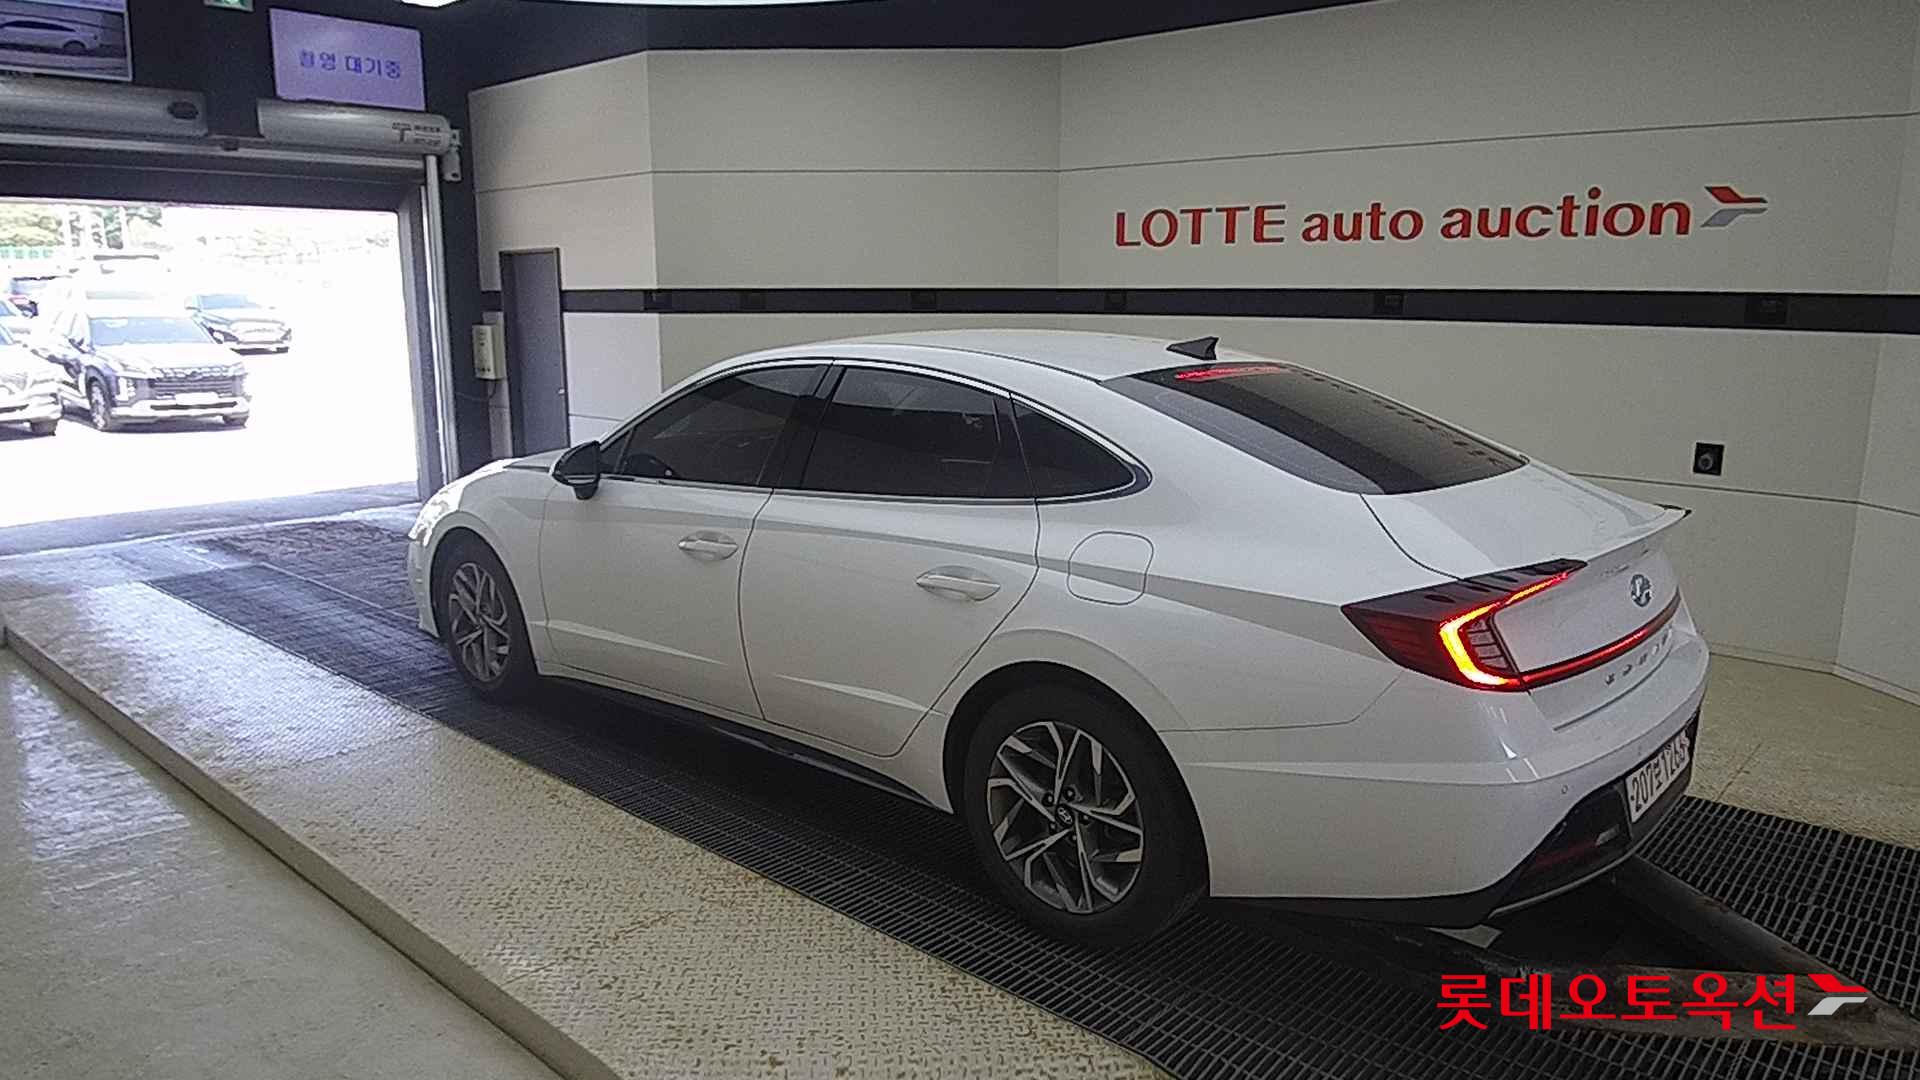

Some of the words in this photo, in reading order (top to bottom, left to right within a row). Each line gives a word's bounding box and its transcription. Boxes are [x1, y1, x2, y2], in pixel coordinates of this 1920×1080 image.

[344, 55, 401, 79] 대기중
[1115, 204, 1286, 247] LOTTE
[1301, 203, 1425, 243] auto
[1440, 186, 1692, 240] auction
